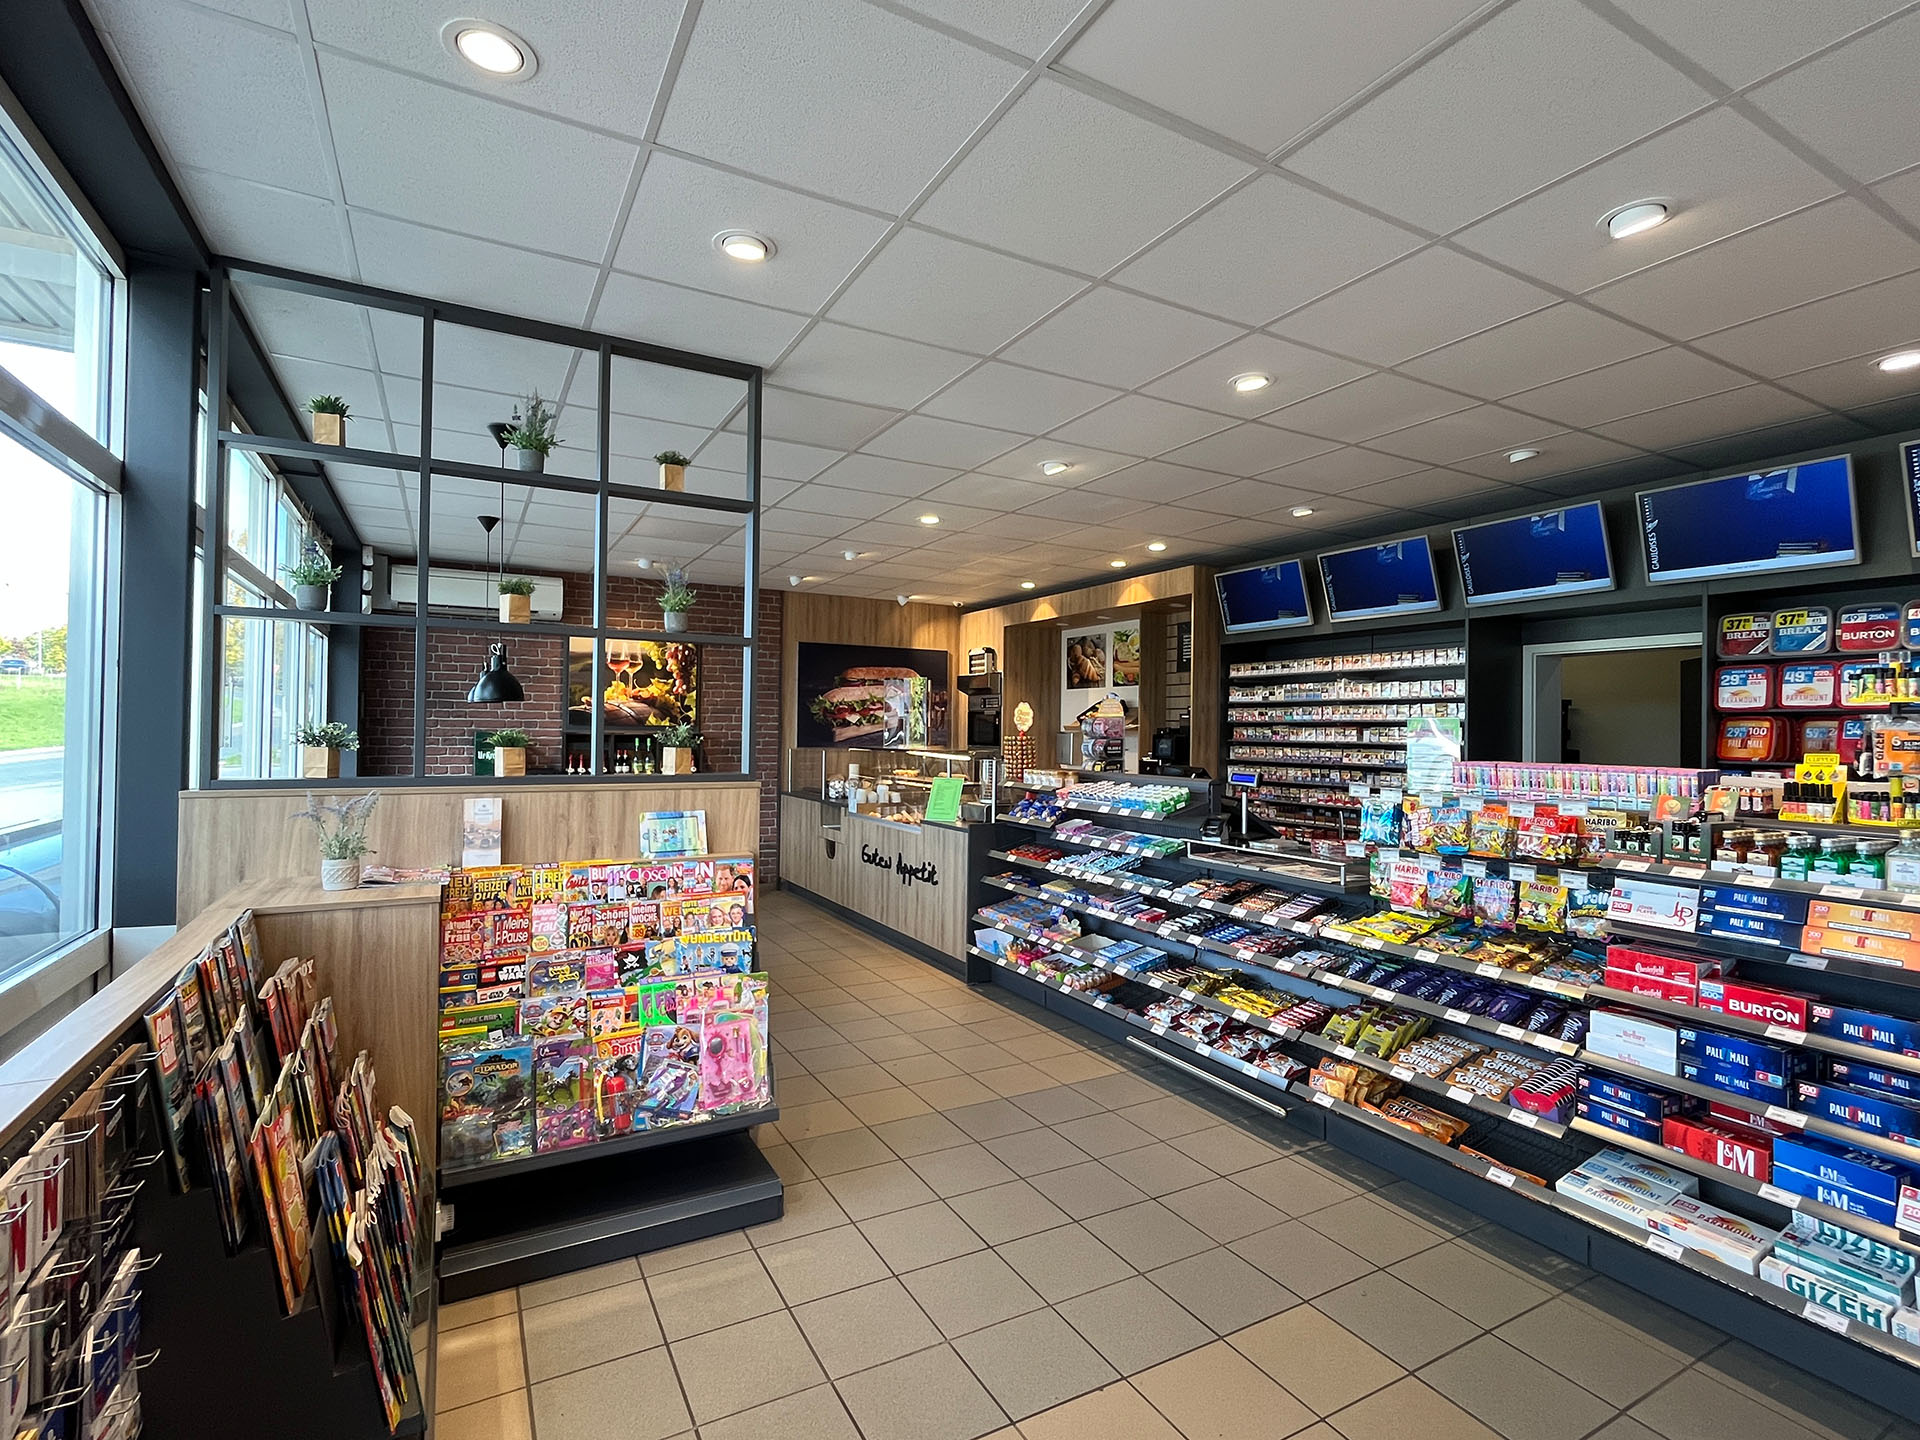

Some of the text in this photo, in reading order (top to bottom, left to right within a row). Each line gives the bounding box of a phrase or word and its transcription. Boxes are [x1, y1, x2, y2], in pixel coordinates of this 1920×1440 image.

[1650, 532, 1660, 570] GAULOISES
[1726, 631, 1767, 640] BREAK
[1778, 626, 1822, 636] BREAK
[1842, 630, 1895, 640] BURTON
[1721, 695, 1762, 704] PARAMOUNT
[1785, 694, 1828, 702] PARAMOUNT
[1478, 811, 1503, 820] HARIBO
[1585, 818, 1617, 827] HARIBO
[896, 852, 939, 887] Appetit
[1394, 864, 1425, 875] HARIBO
[473, 880, 508, 892] FREIZEIT
[1475, 879, 1512, 890] HARIBO
[1528, 883, 1559, 895] HARIBO
[1572, 890, 1610, 906] Troll
[1733, 893, 1768, 906] PALL MALL
[595, 910, 628, 921] Schöne
[632, 904, 656, 914] meine
[503, 917, 529, 930] Meine
[532, 920, 558, 933] Frau
[631, 913, 657, 924] WOCHE
[1729, 918, 1764, 931] PALL MALL
[444, 930, 470, 943] Frau
[502, 930, 529, 944] Pause
[1729, 999, 1799, 1025] BURTON
[1812, 1006, 1830, 1015] 200
[1560, 1018, 1582, 1041] Milka
[1843, 1023, 1895, 1045] PALL MALL
[1437, 1035, 1480, 1053] Toffifee
[1410, 1045, 1453, 1065] Toffifee
[1495, 1051, 1543, 1071] Toffifee
[1705, 1045, 1749, 1066] PALL MALL
[474, 1062, 518, 1074] ELDRADOR
[1398, 1053, 1440, 1074] Toffifee
[1482, 1058, 1529, 1080] Toffifee
[1833, 1064, 1848, 1072] 200
[1455, 1072, 1501, 1096] Toffifee
[1715, 1074, 1750, 1090] PALL MALL
[1868, 1071, 1910, 1089] PALL MALL
[1603, 1085, 1631, 1101] PALL MALL
[1799, 1084, 1817, 1094] 200
[1601, 1111, 1629, 1128] PALL MALL
[1829, 1103, 1882, 1127] PALL MALL
[1717, 1139, 1755, 1178] L&M
[1621, 1161, 1681, 1187] PARAMOUNT
[1603, 1174, 1662, 1200] PARAMOUNT
[1585, 1187, 1644, 1215] PARAMOUNT
[1817, 1186, 1848, 1211] L&M
[1696, 1213, 1767, 1244] PARAMOUNT
[1786, 1273, 1882, 1329] GIZEH
